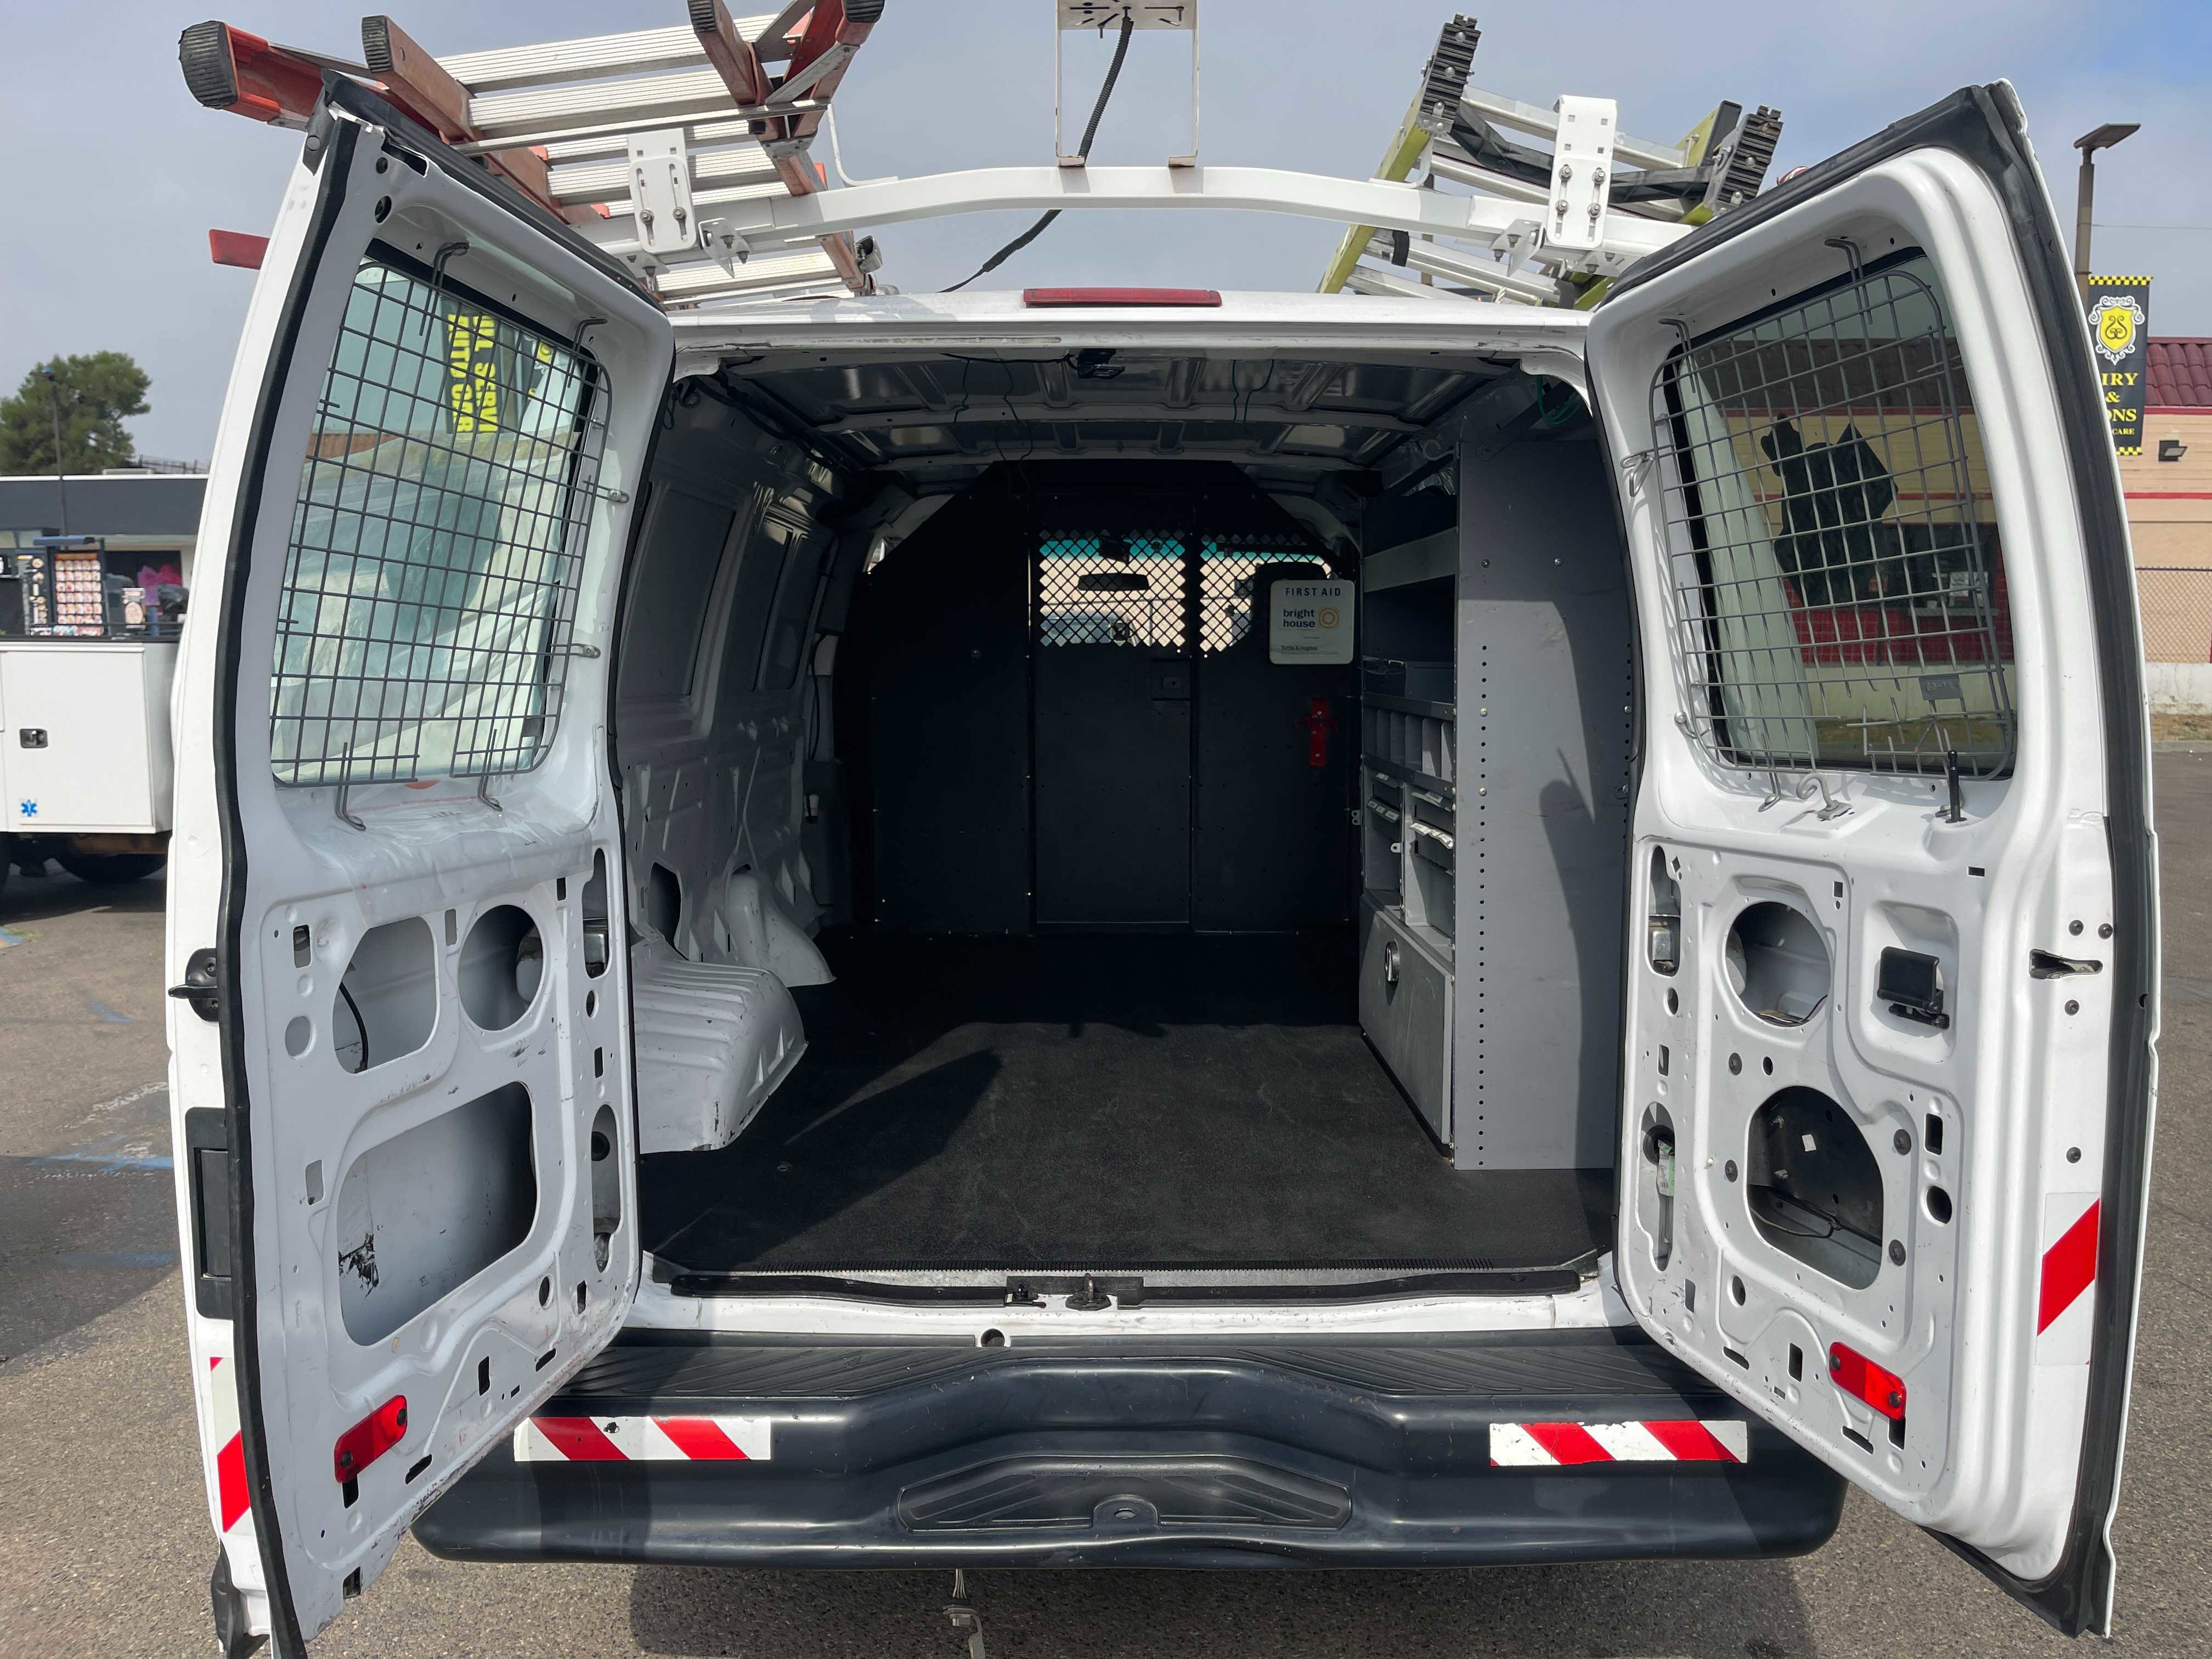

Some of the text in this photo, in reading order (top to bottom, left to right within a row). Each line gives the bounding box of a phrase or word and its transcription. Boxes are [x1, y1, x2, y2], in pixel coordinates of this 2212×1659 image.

[2106, 391, 2120, 403] &
[1285, 588, 1341, 596] FIRST AID
[1283, 608, 1315, 619] bright
[1283, 619, 1316, 628] house
